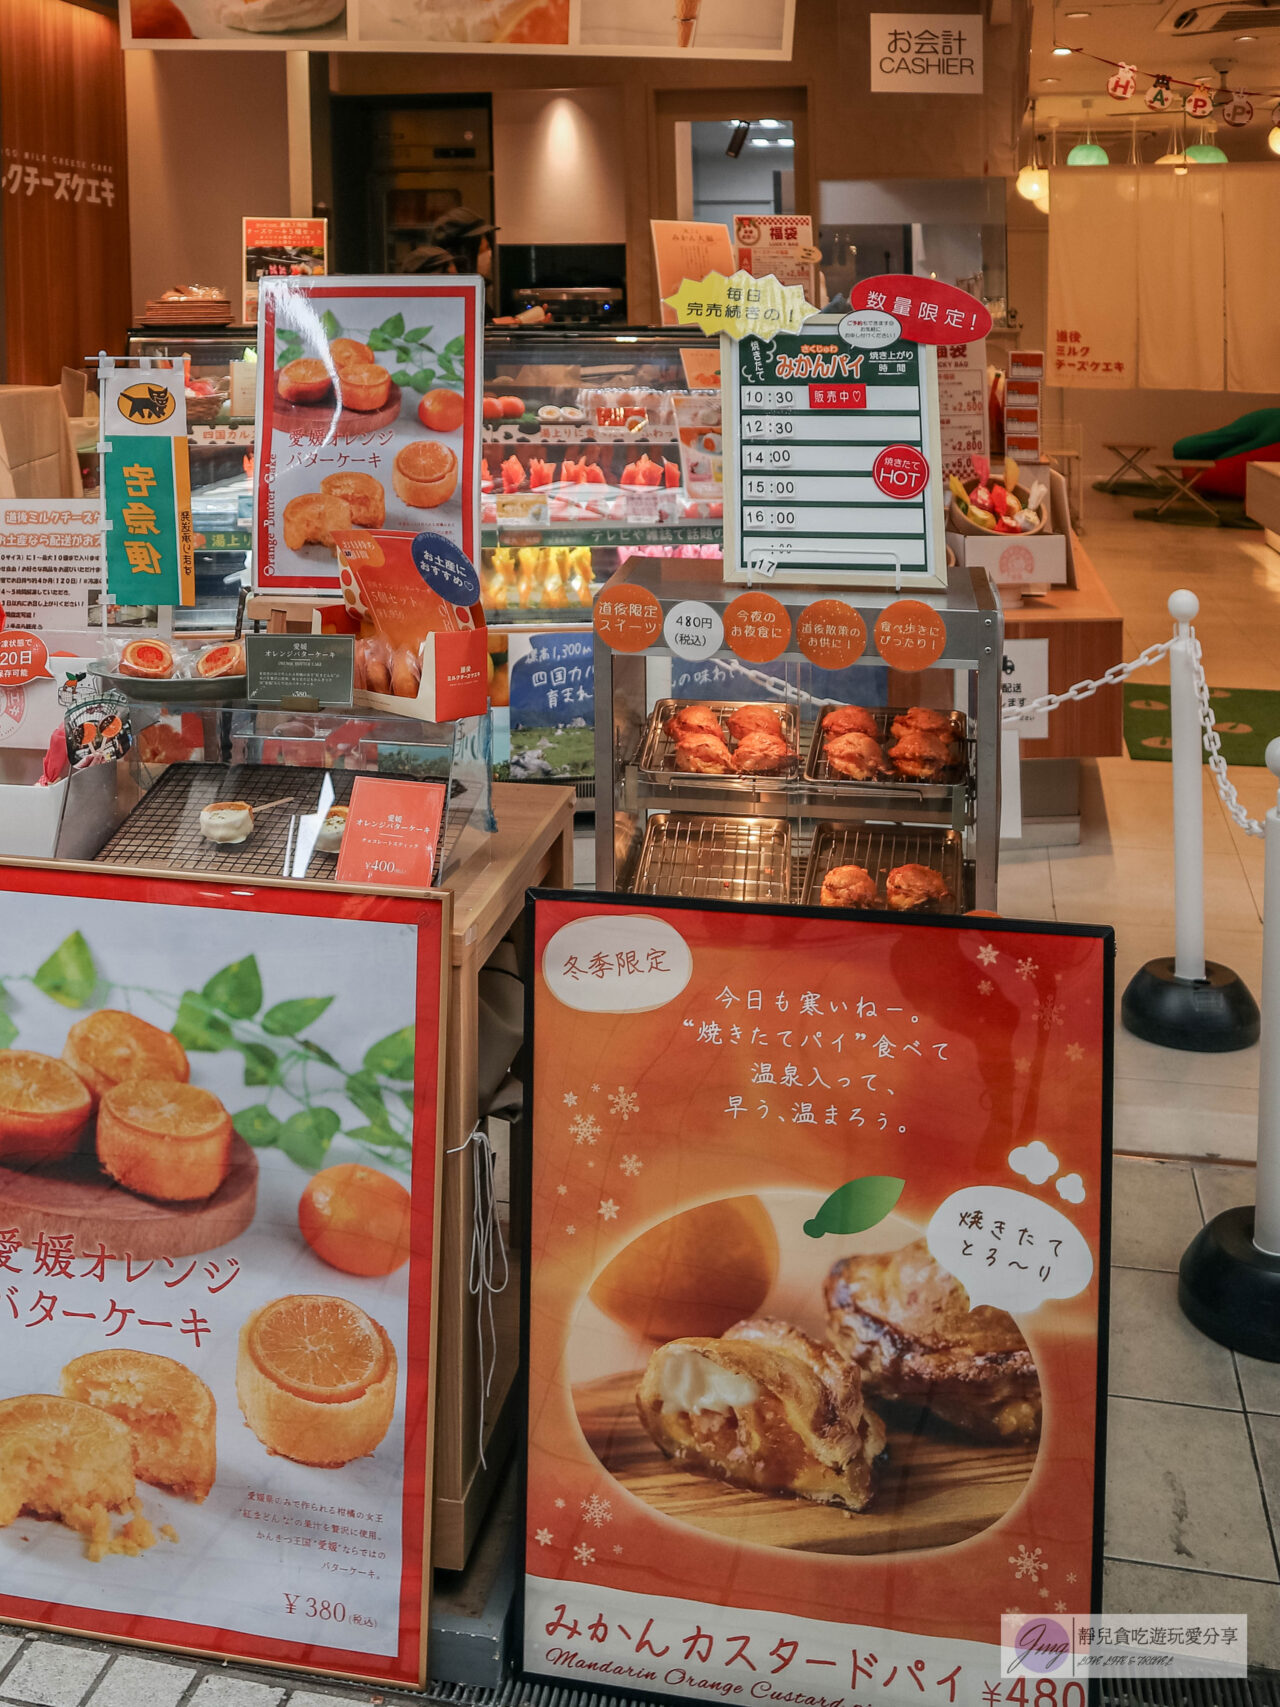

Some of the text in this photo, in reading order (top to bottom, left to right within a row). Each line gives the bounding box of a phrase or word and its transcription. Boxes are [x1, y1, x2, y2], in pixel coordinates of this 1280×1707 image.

[888, 29, 967, 55] お会計
[879, 57, 975, 75] CASHIER
[769, 227, 797, 240] 福袋
[726, 287, 761, 303] 毎日
[686, 302, 796, 323] 完売続きの！
[865, 290, 977, 331] 数量限定！
[869, 351, 914, 359] 焼き上がり
[1056, 345, 1090, 357] ミルク
[775, 354, 864, 379] みかんパイ
[746, 391, 794, 403] 10:30
[746, 420, 794, 435] 12:30
[288, 429, 394, 448] 愛媛オレンジ
[286, 452, 383, 469] バターケーキ
[746, 449, 791, 464] 14:00
[884, 457, 919, 470] 焼きたて
[747, 481, 795, 494] 15:00
[879, 471, 921, 488] HOT
[747, 511, 796, 524] 16:00
[263, 520, 278, 576] Orange
[423, 550, 468, 577] お土産に
[599, 603, 658, 619] 道後限定
[736, 609, 776, 624] 今夜の
[599, 616, 658, 633] スイーツ
[675, 614, 713, 629] 480円
[880, 621, 940, 637] 食べ歩きに
[731, 624, 782, 640] お夜食に
[801, 623, 861, 638] 道後散策の
[674, 632, 707, 647] (税込)
[265, 650, 335, 658] オレンジバターケーキ
[357, 819, 430, 834] オレンジバターケーキ
[365, 860, 395, 872] ¥400
[562, 947, 672, 980] 冬季限定
[714, 986, 920, 1025] 今日も寒いねー。
[750, 1061, 897, 1097] 温泉入って、
[723, 1095, 908, 1136] 早う、温まろう。
[958, 1209, 1064, 1258] 焼きたて
[545, 1603, 962, 1702] みかんカスタードパイ
[545, 1647, 844, 1707] Mandarin Orange Custard
